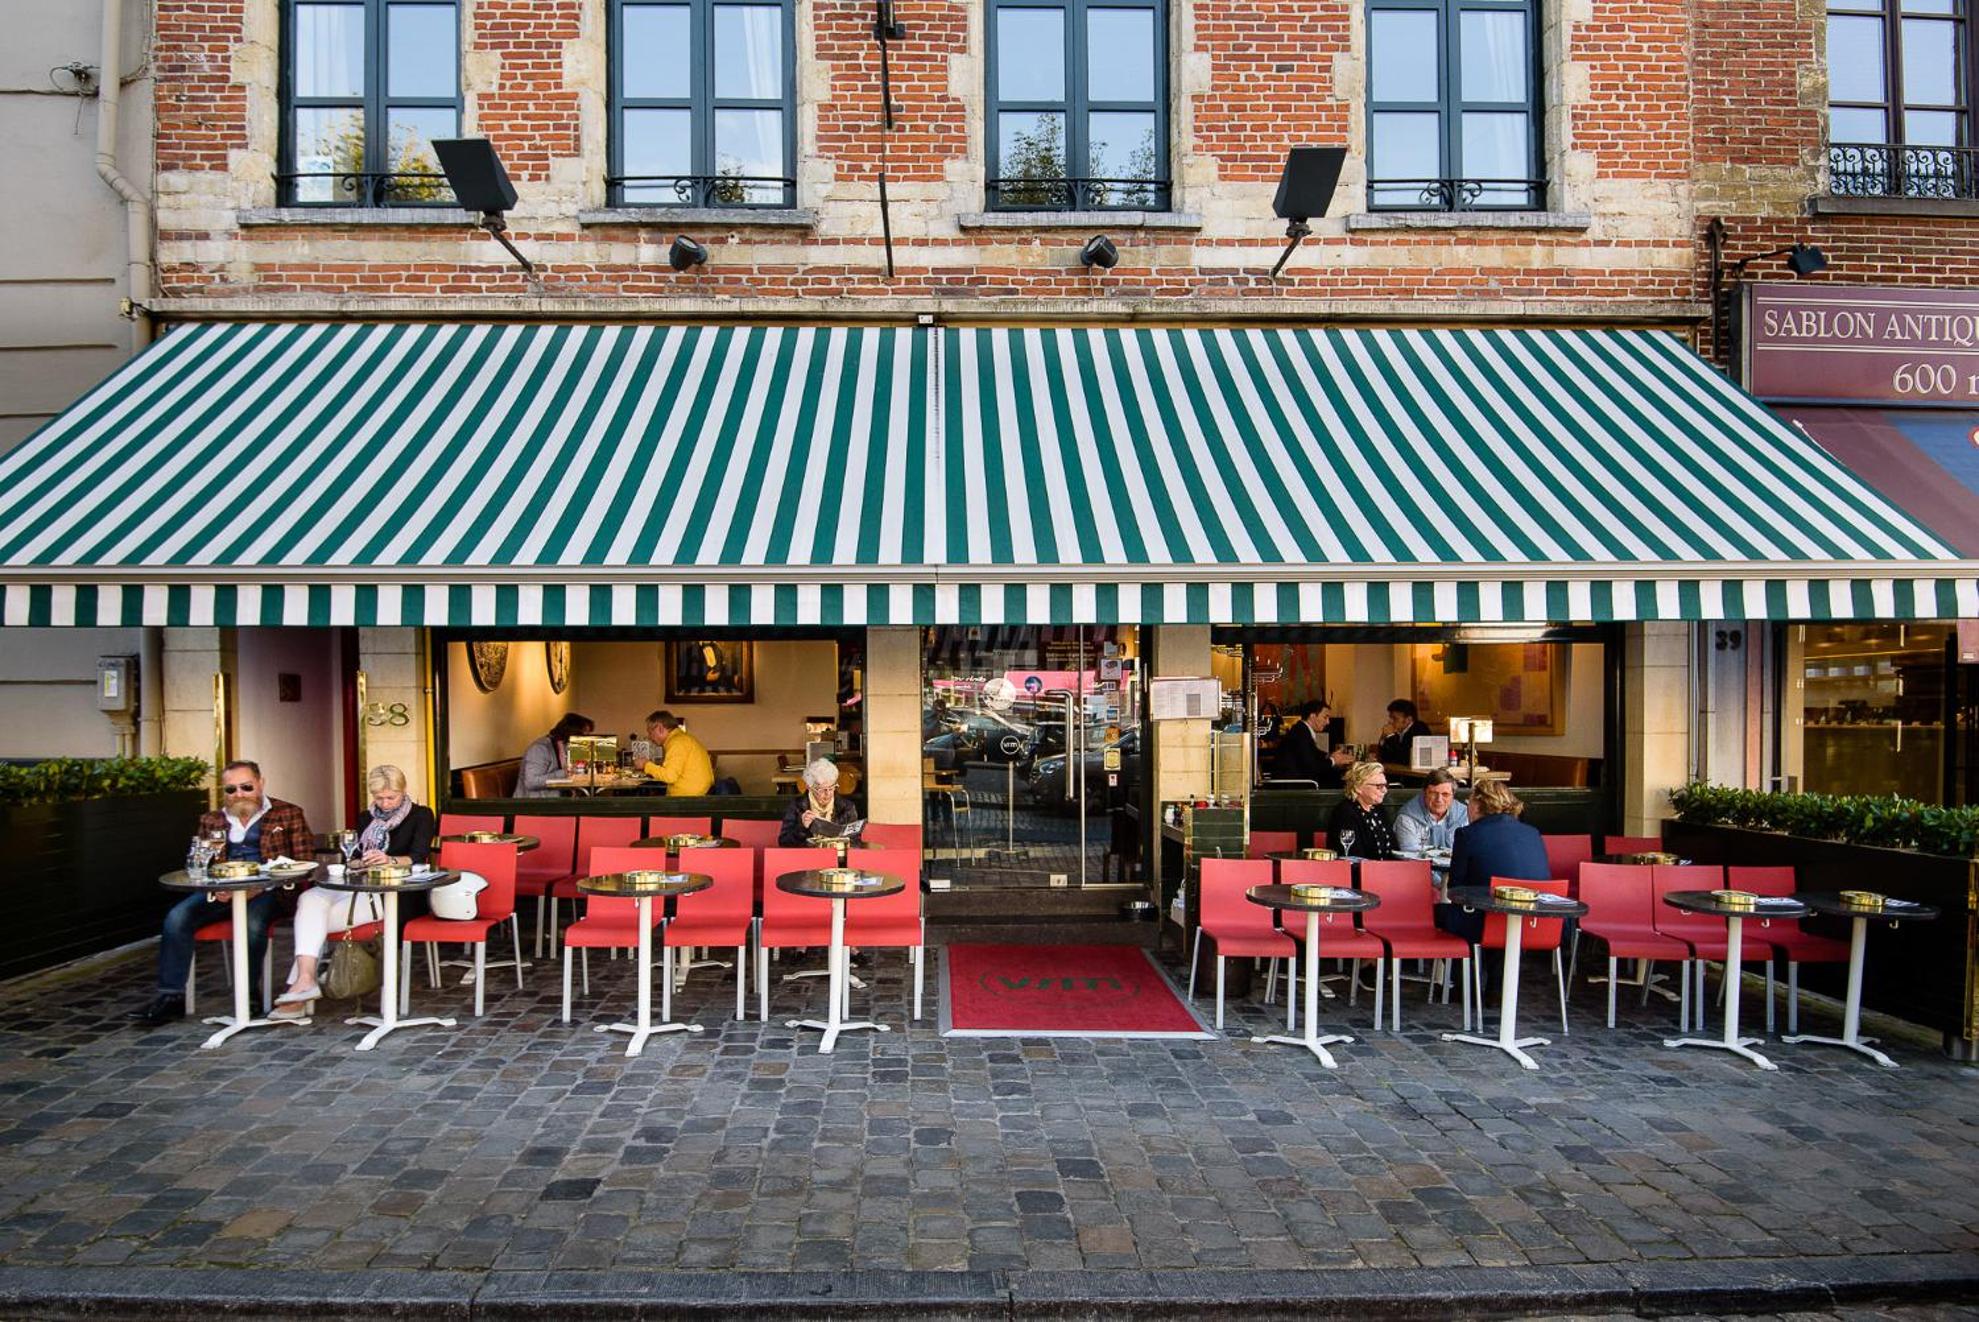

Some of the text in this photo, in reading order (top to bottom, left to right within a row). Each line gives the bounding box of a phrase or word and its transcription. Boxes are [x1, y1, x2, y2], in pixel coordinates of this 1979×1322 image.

[1764, 309, 1979, 347] SABLON ANTIQ
[1893, 363, 1957, 394] 600
[1715, 630, 1742, 651] 39
[368, 702, 410, 727] 38
